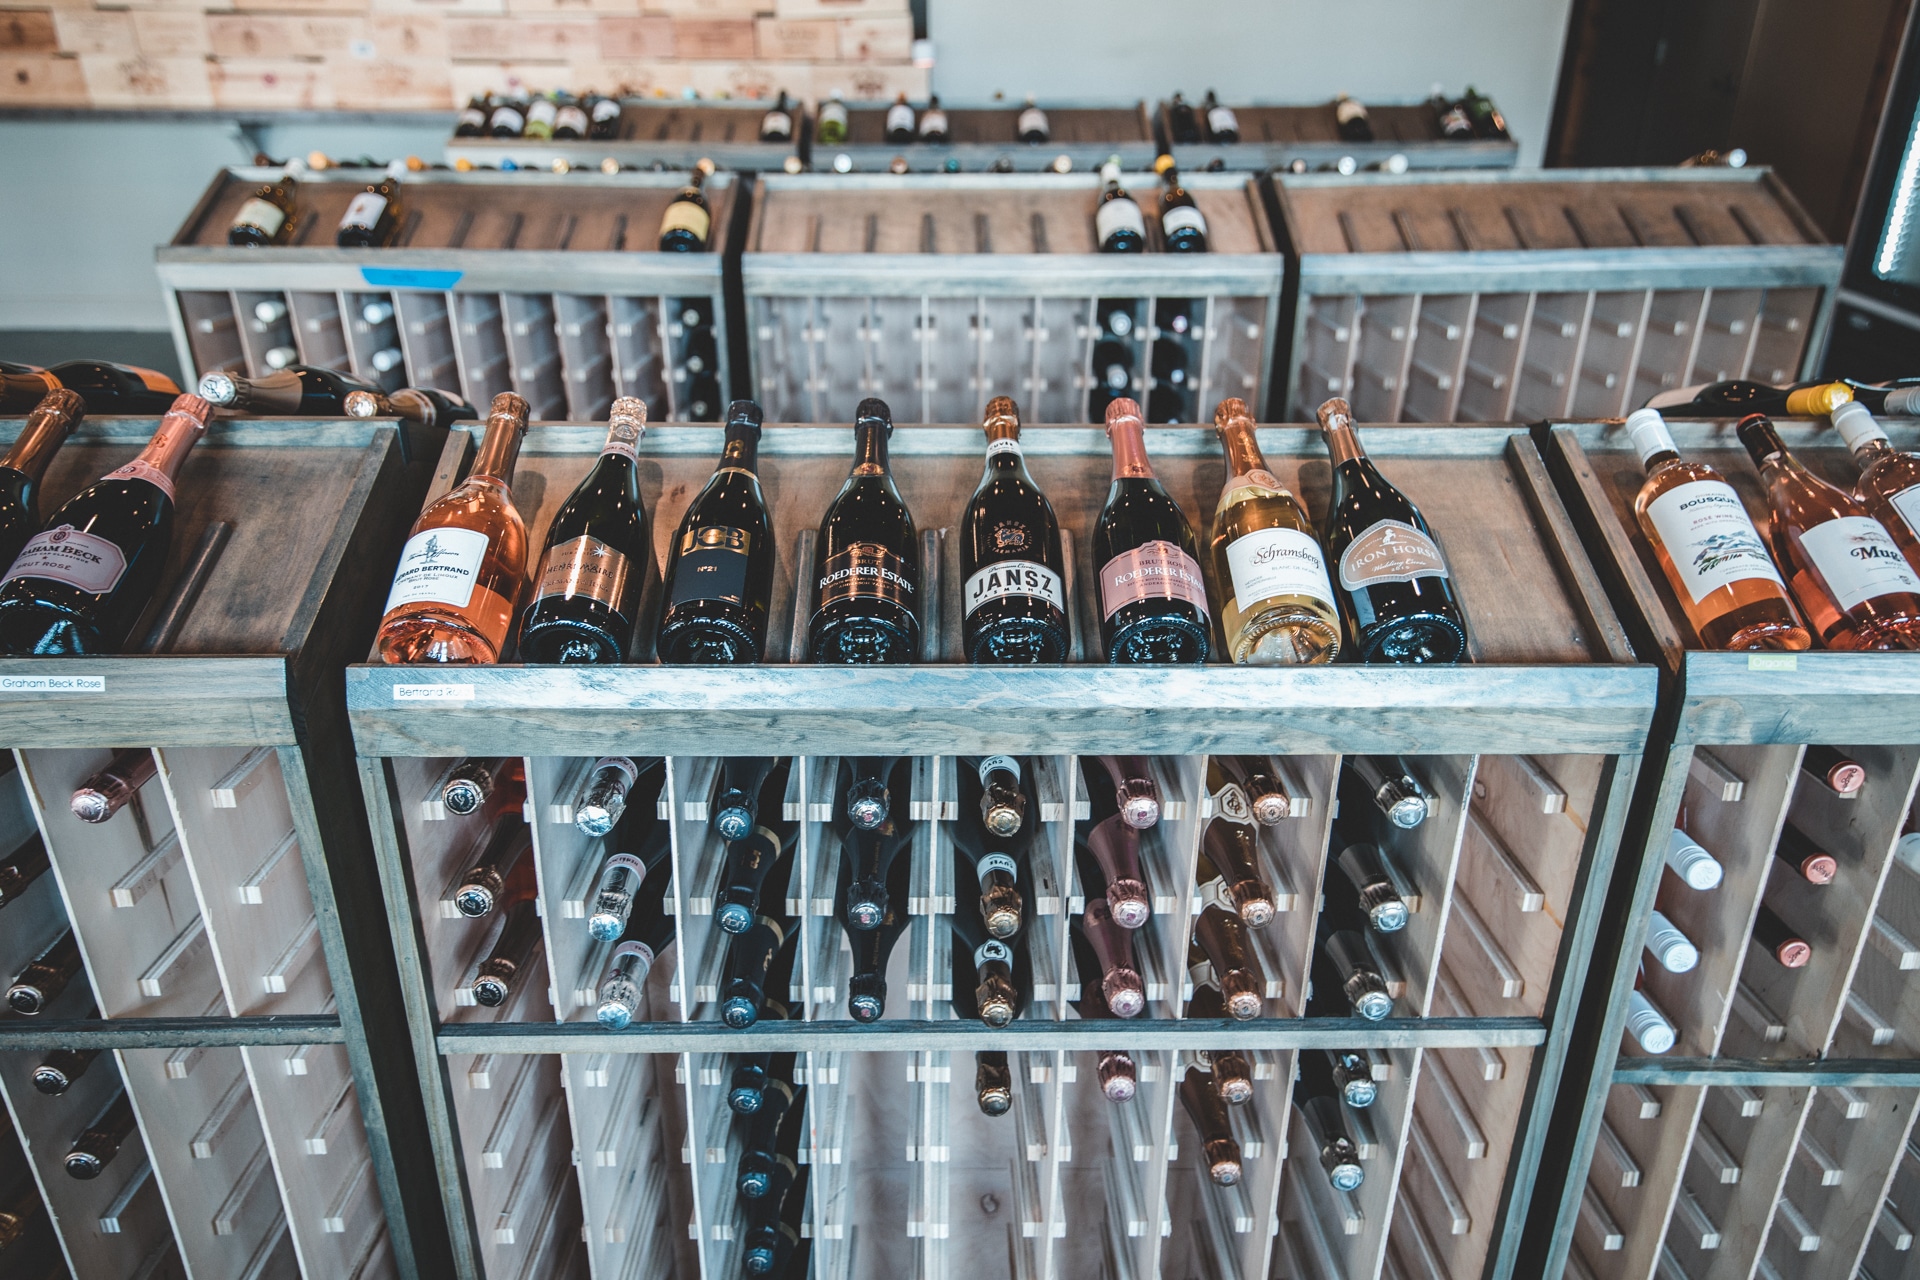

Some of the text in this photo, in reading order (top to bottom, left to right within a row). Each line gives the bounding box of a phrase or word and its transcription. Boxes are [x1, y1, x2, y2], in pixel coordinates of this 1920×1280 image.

[684, 526, 744, 552] JCB
[62, 546, 103, 564] BECK
[1249, 544, 1321, 569] Schramsberg
[1351, 549, 1387, 572] IRON
[422, 565, 470, 576] BERTRAND
[820, 566, 878, 589] ROEDERER
[1115, 566, 1177, 587] ROEDERER
[974, 569, 1053, 598] JANSZ
[2, 678, 101, 688] Graham Beck Rose
[399, 687, 443, 697] Bertrand
